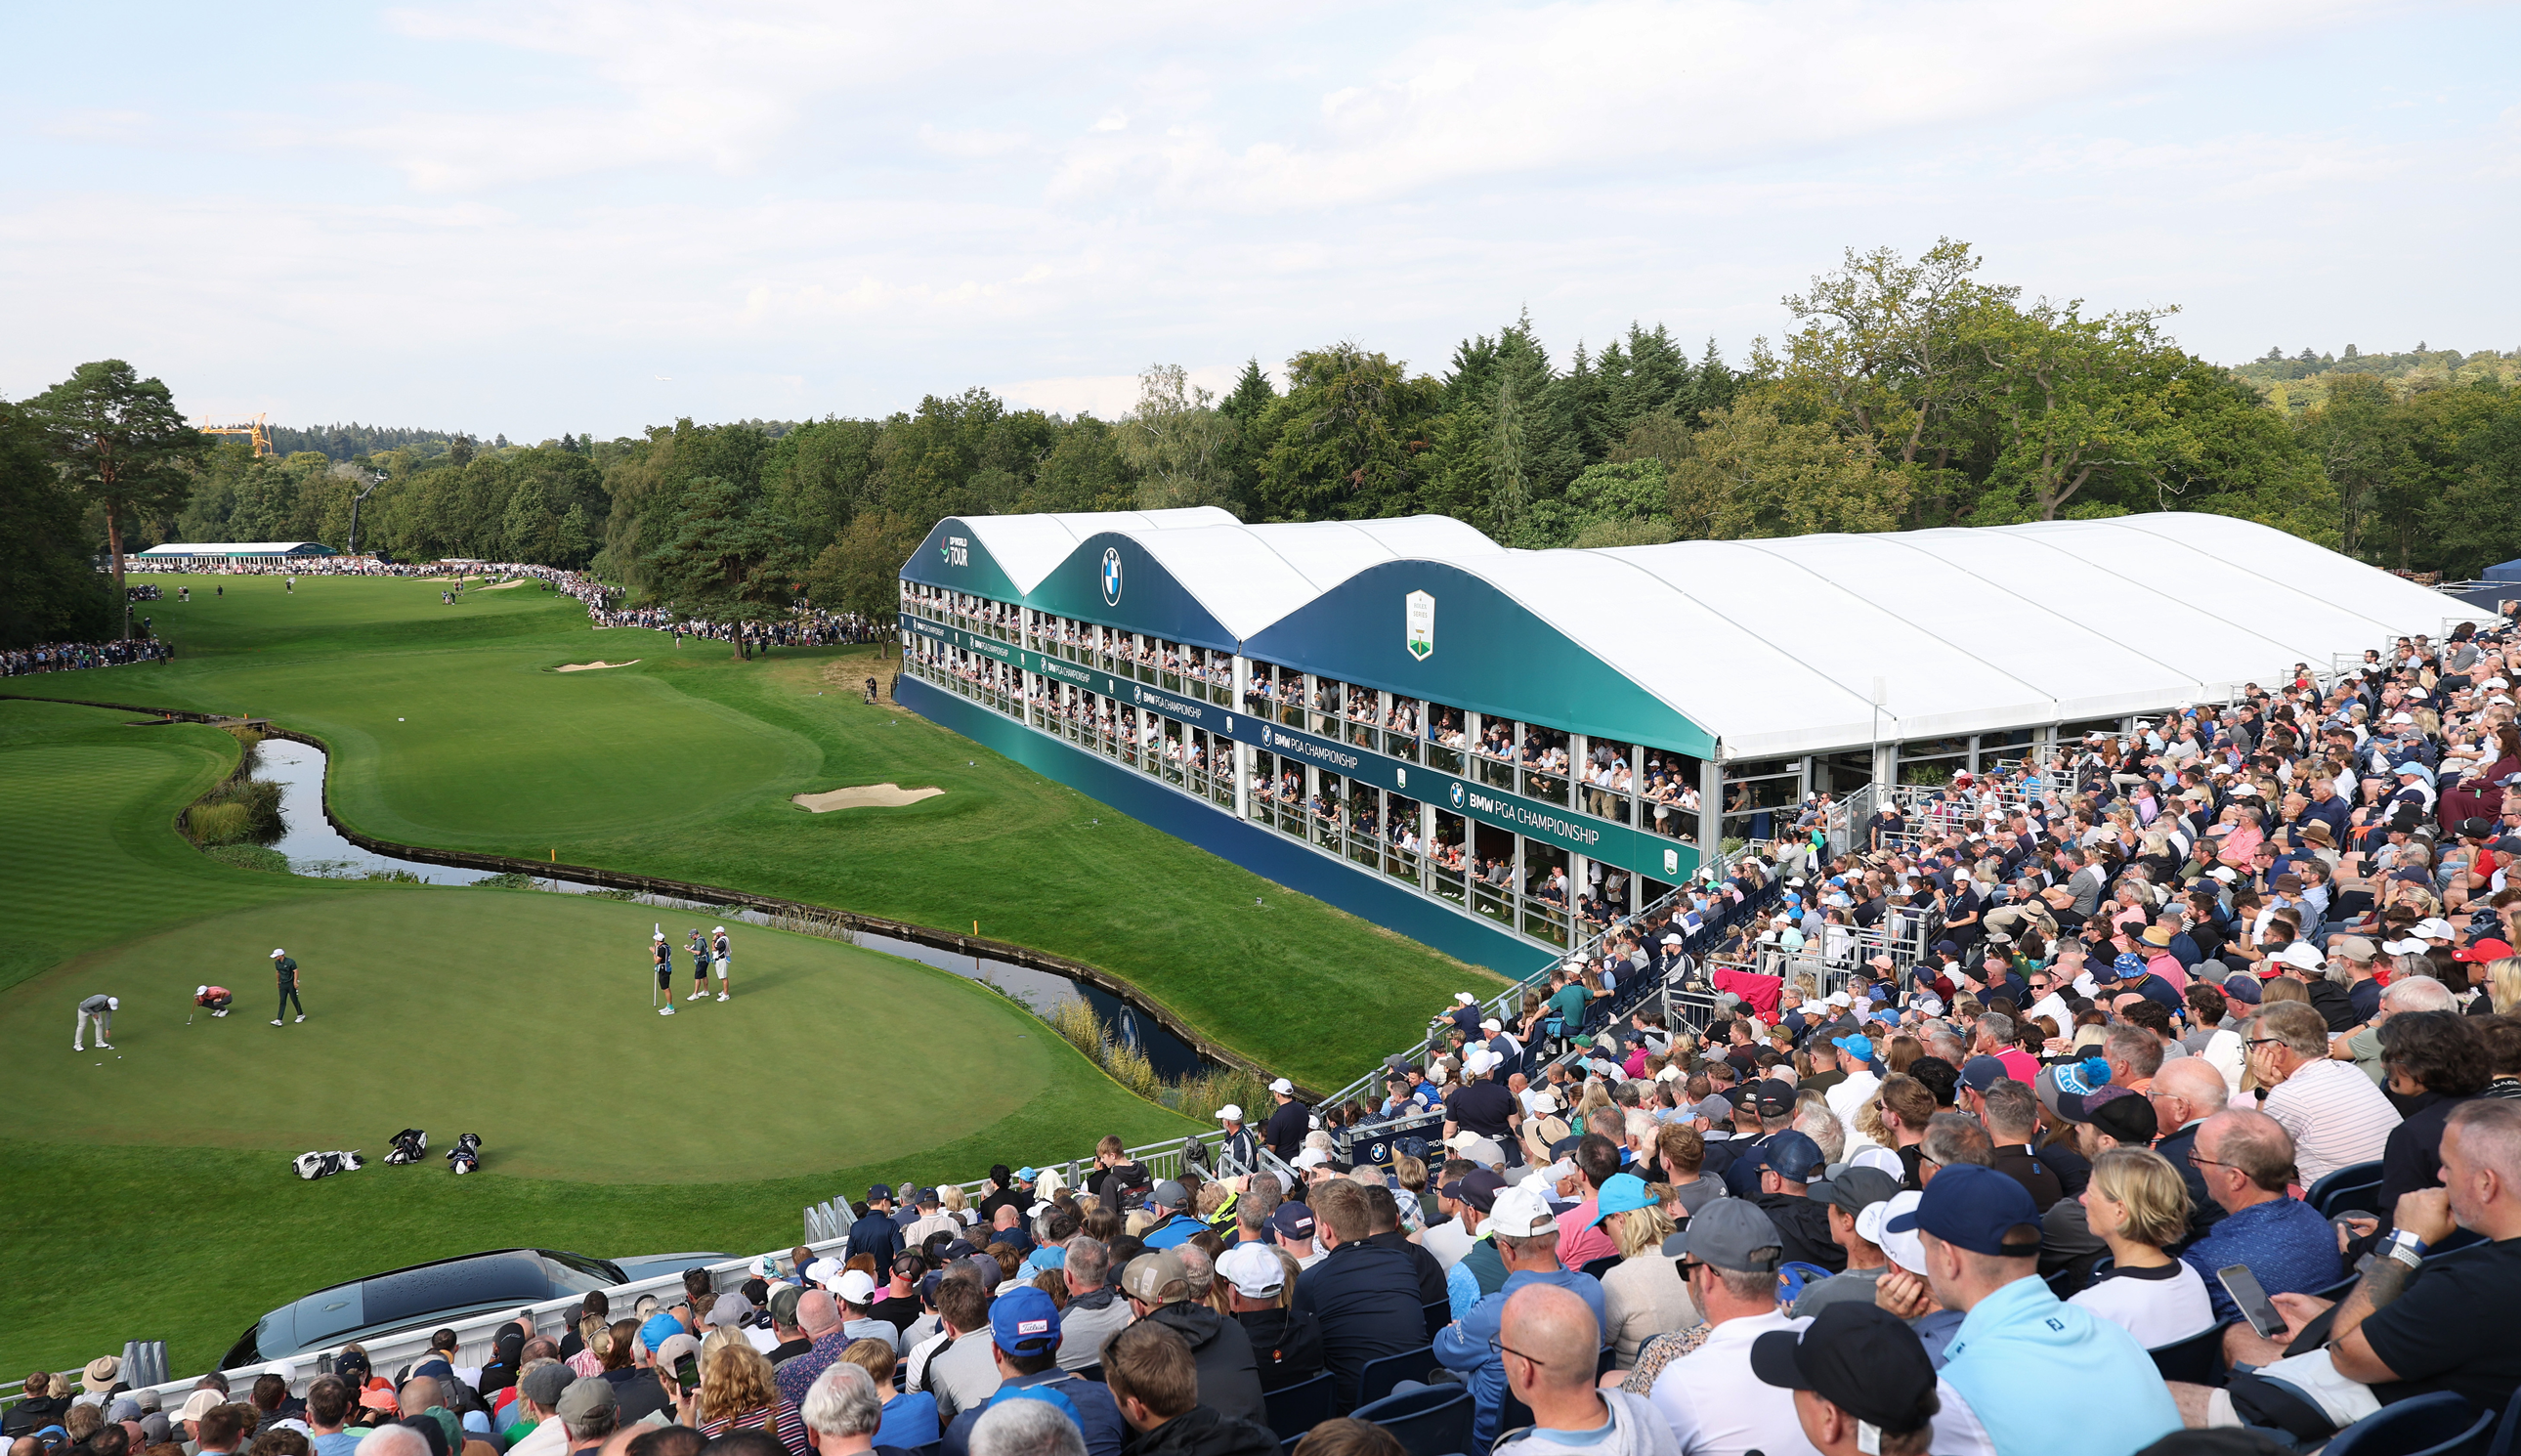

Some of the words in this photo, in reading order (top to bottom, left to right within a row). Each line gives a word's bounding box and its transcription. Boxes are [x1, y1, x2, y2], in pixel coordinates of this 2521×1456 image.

[949, 546, 968, 568] TOUR
[1143, 691, 1155, 705] BMW
[1155, 695, 1164, 707] PGA
[1164, 699, 1202, 719] CHAMPIONSHIP
[1274, 732, 1291, 749] BMW
[1291, 738, 1304, 753] PGA
[1304, 743, 1358, 769] CHAMPIONSHIP
[1470, 792, 1494, 813] BMW
[1495, 800, 1516, 821] PGA
[1517, 807, 1600, 846] CHAMPIONSHIP
